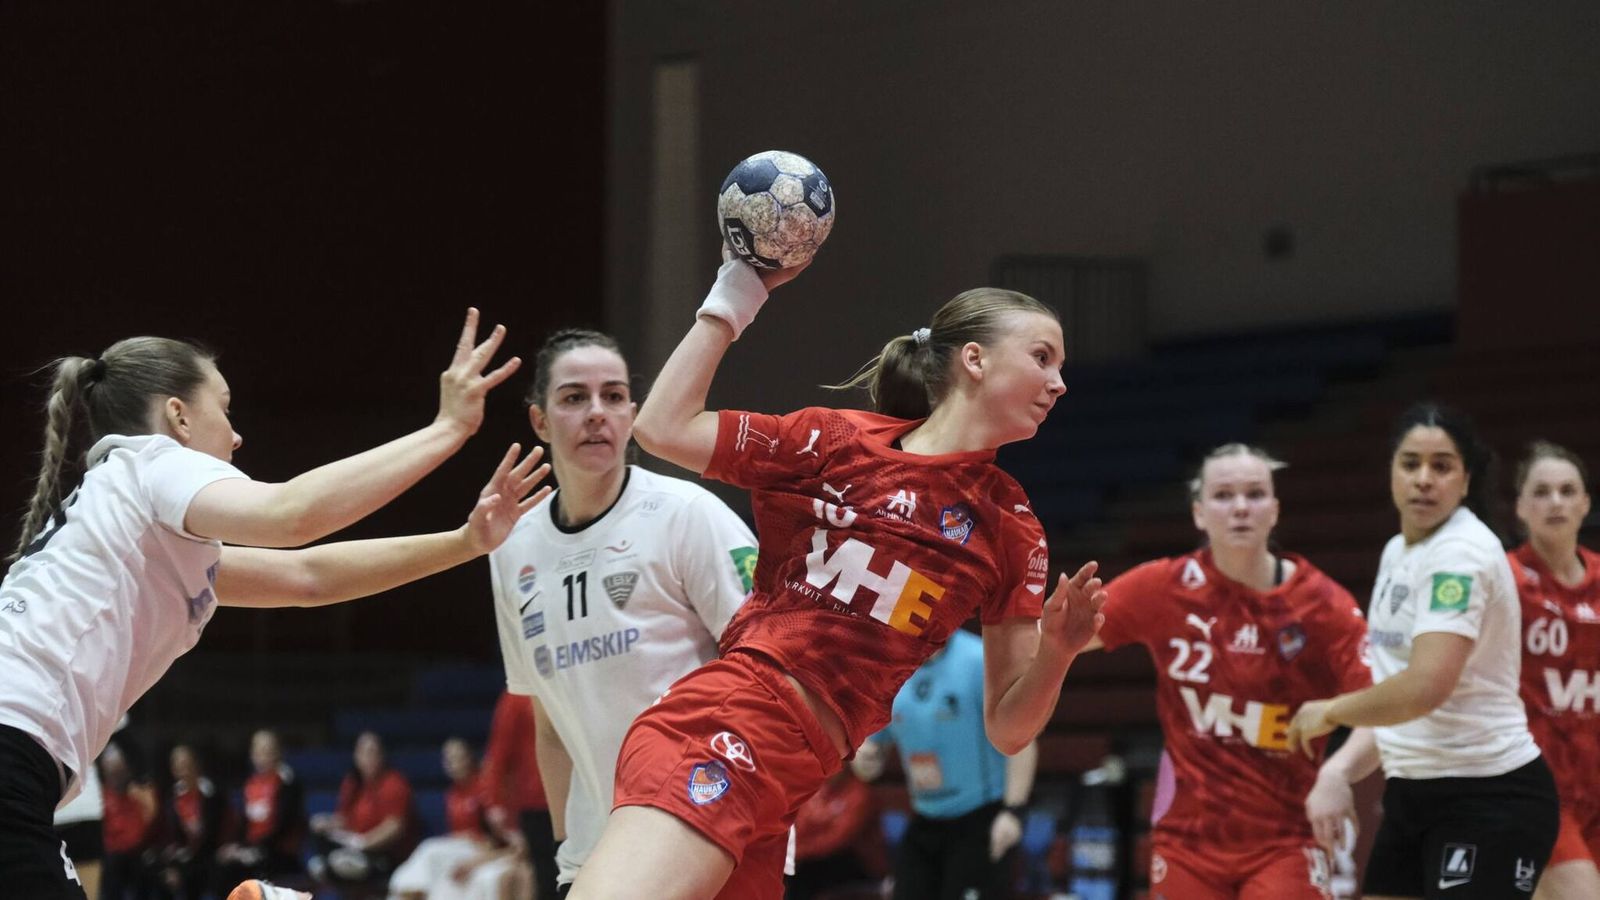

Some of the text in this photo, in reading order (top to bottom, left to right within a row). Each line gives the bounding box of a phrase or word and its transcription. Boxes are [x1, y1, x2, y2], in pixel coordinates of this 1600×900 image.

[562, 571, 588, 621] 11
[805, 530, 946, 637] VHE
[556, 627, 640, 670] EIMSKIP
[1526, 616, 1568, 657] 60
[1168, 638, 1213, 683] 22
[1179, 687, 1290, 751] VHE
